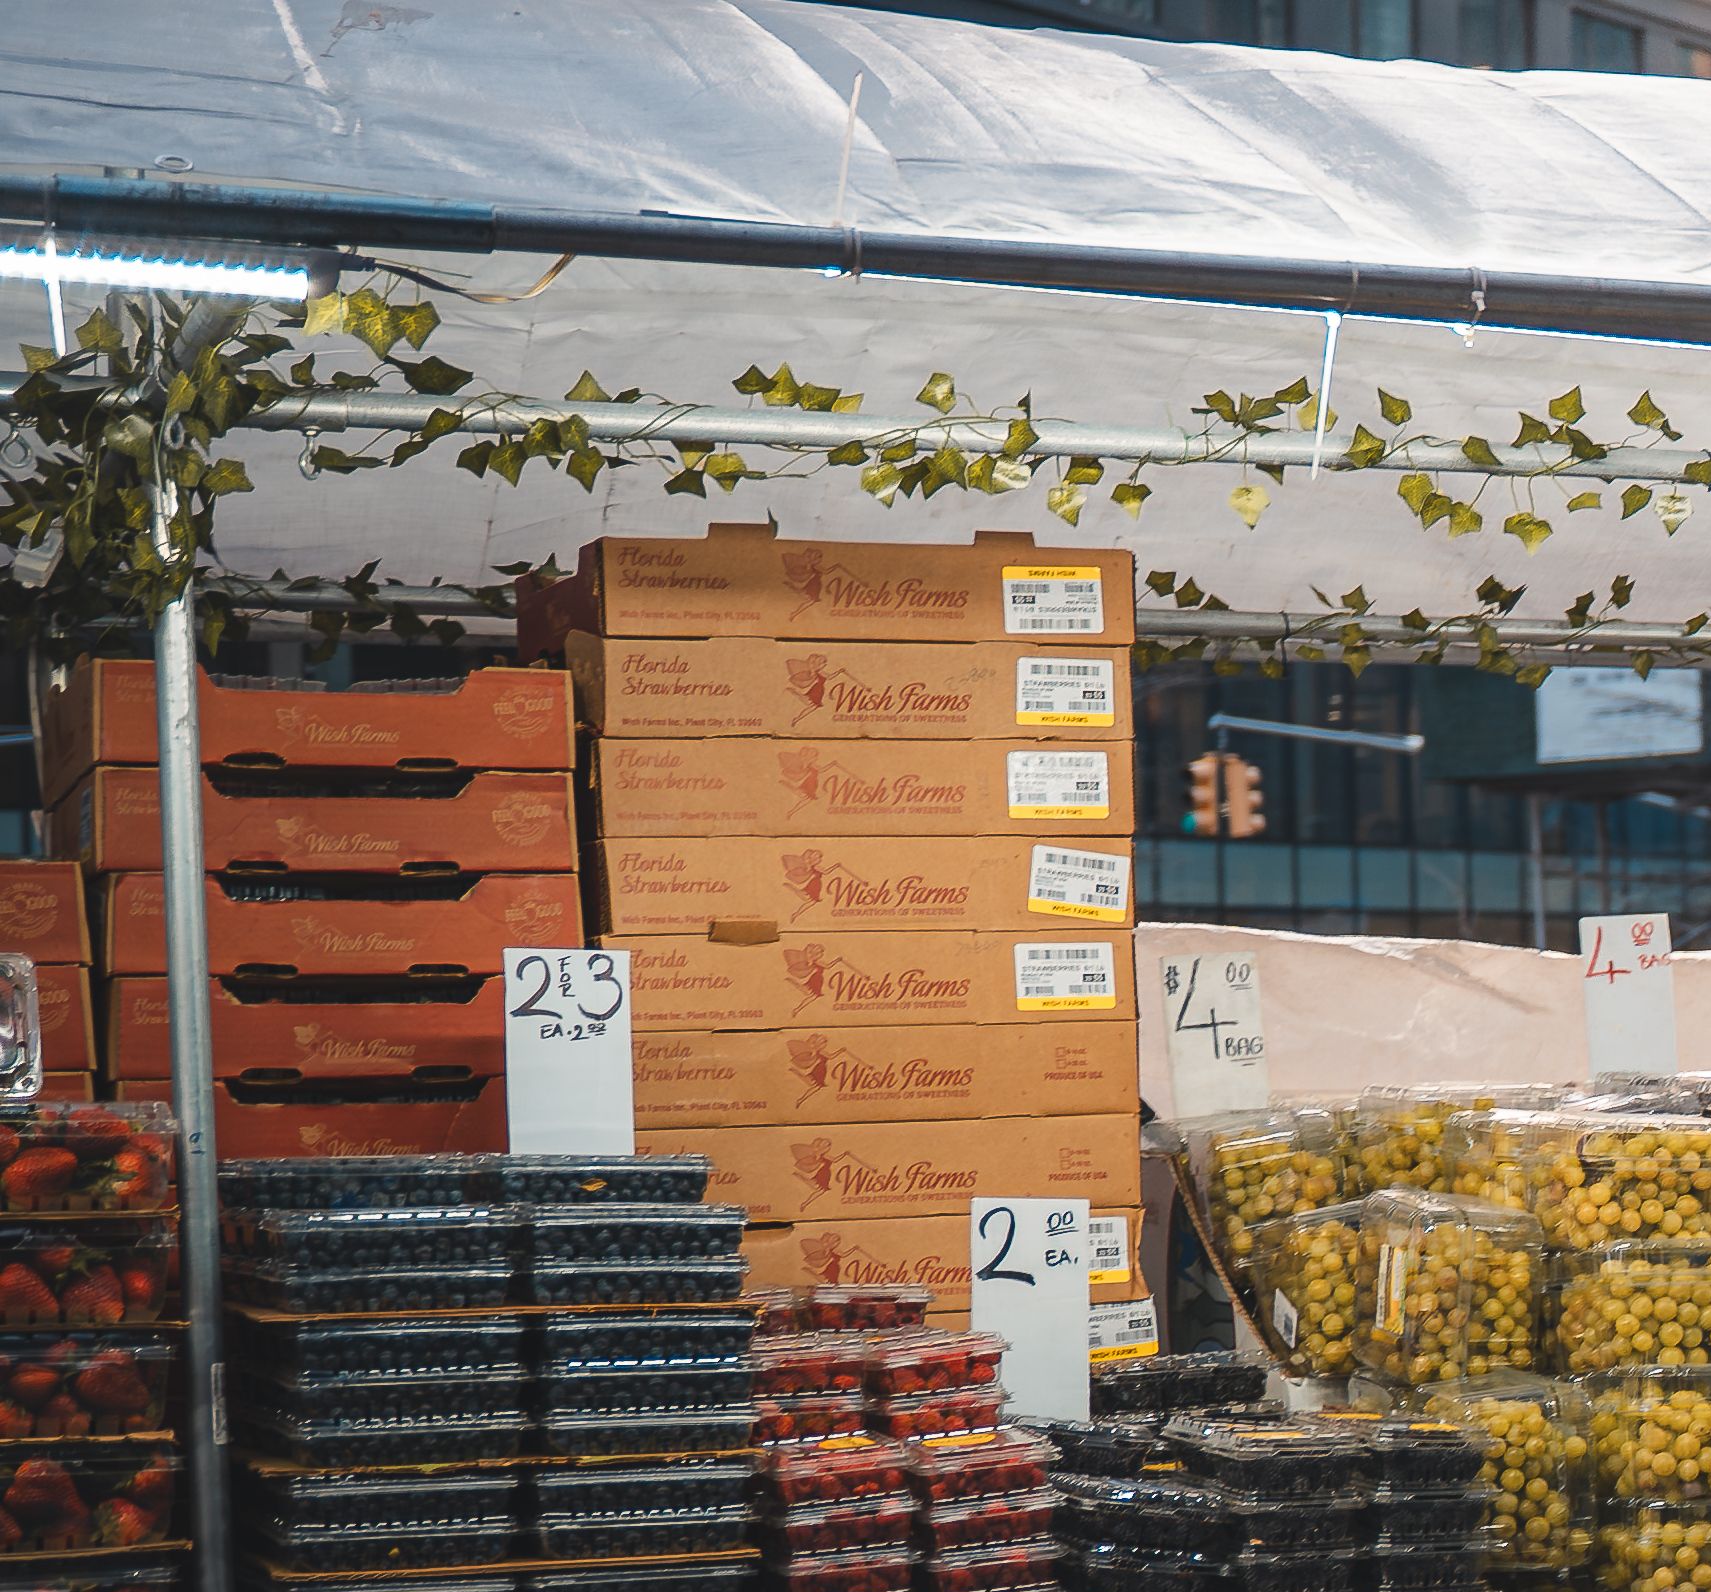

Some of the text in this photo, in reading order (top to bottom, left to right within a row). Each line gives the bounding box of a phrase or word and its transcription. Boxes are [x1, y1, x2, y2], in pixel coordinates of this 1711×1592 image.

[619, 546, 686, 567] Florida
[619, 570, 729, 591] Strawberries
[825, 577, 969, 609] Wish Farms
[622, 654, 689, 675] Florida
[622, 676, 734, 697] Strawberries
[829, 682, 972, 713] Wish Farms
[306, 723, 400, 743] Wish Farms
[616, 748, 684, 769] Florida
[616, 770, 727, 790] Strawberries
[822, 775, 966, 806] Wish Farms
[306, 833, 399, 853] Wish Farms
[619, 853, 687, 873] Florida
[619, 876, 730, 895] Strawberries
[826, 875, 969, 908] Wish Farms
[320, 932, 415, 952] Wish Farms
[1586, 926, 1632, 985] 4
[1638, 953, 1672, 969] BAG
[510, 953, 623, 1021] 2 FOR 3
[829, 969, 970, 1001] Wish Farms
[1176, 957, 1239, 1059] 4
[1225, 962, 1251, 988] 00
[321, 1039, 416, 1058] Wish Farms
[1225, 1036, 1264, 1057] BAG
[832, 1059, 974, 1092] Wish Farms
[836, 1161, 977, 1194] Wish Farms
[976, 1206, 1076, 1286] 2 00
[847, 1257, 972, 1285] Wish Farm
